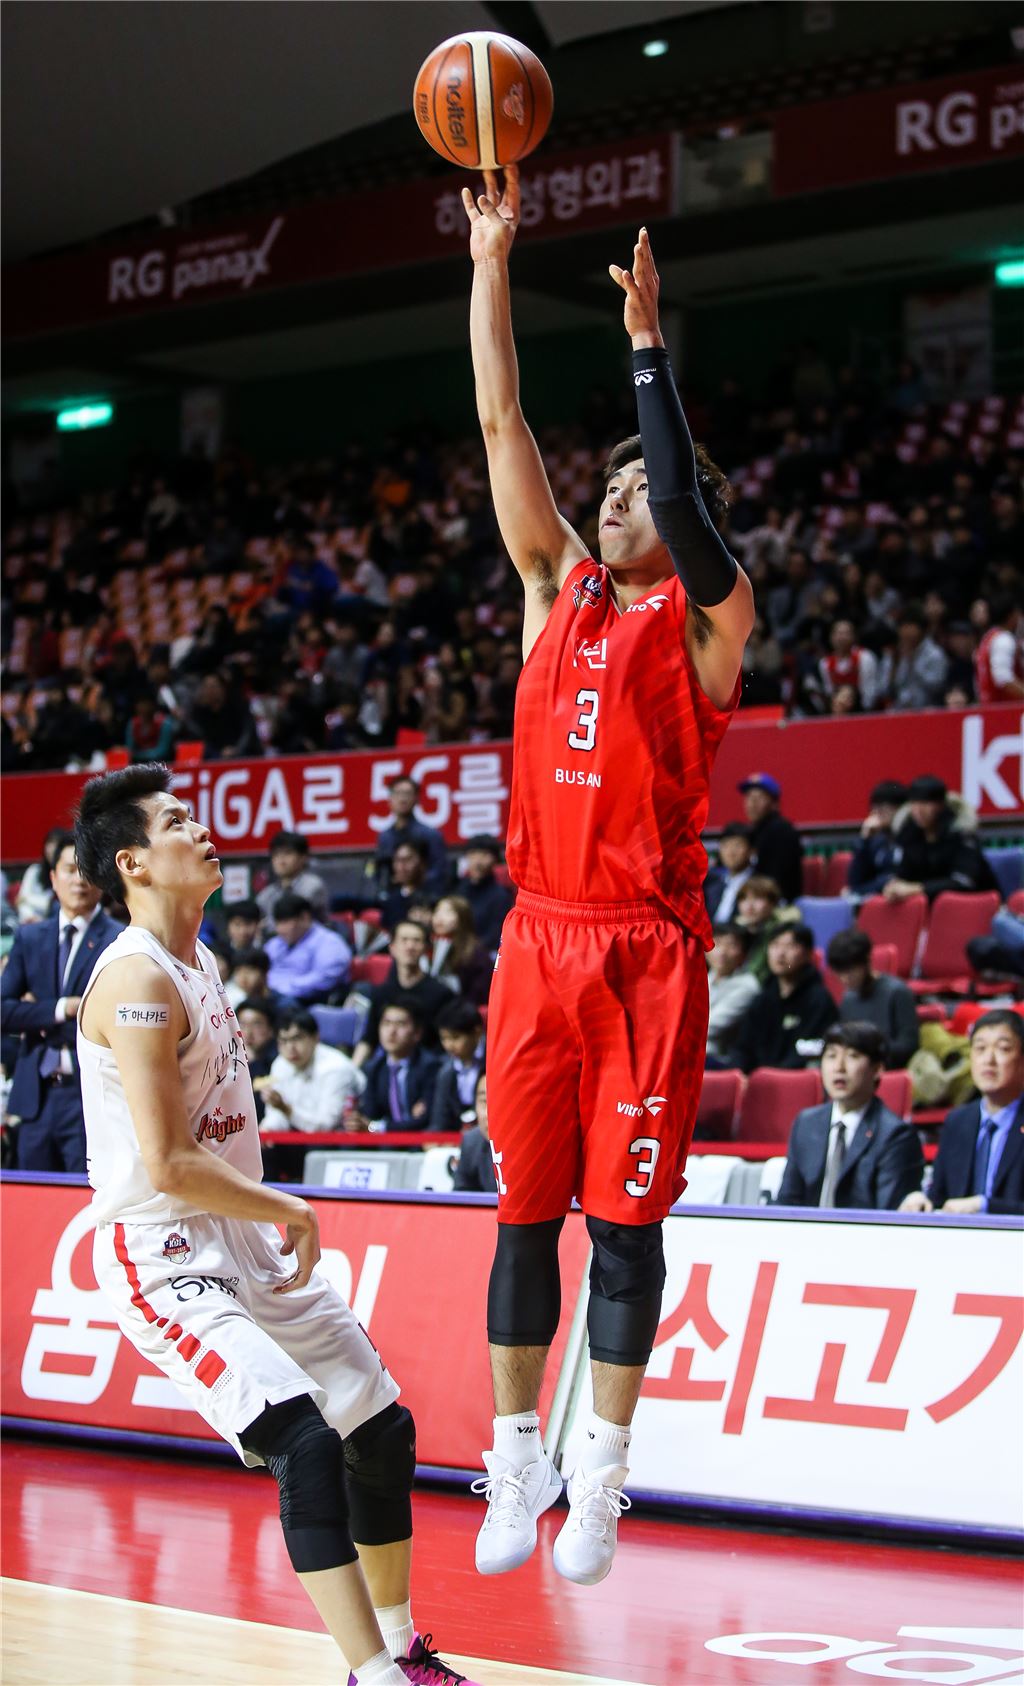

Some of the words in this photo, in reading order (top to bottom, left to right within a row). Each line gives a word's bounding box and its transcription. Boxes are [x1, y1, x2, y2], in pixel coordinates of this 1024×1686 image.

[897, 91, 976, 155] RG
[109, 251, 164, 302] RG
[173, 217, 275, 299] panax
[567, 688, 600, 752] 3
[555, 768, 602, 788] BUSAN
[131, 1009, 168, 1023] 하나카드
[616, 1101, 644, 1118] vitro
[624, 1136, 662, 1199] 3
